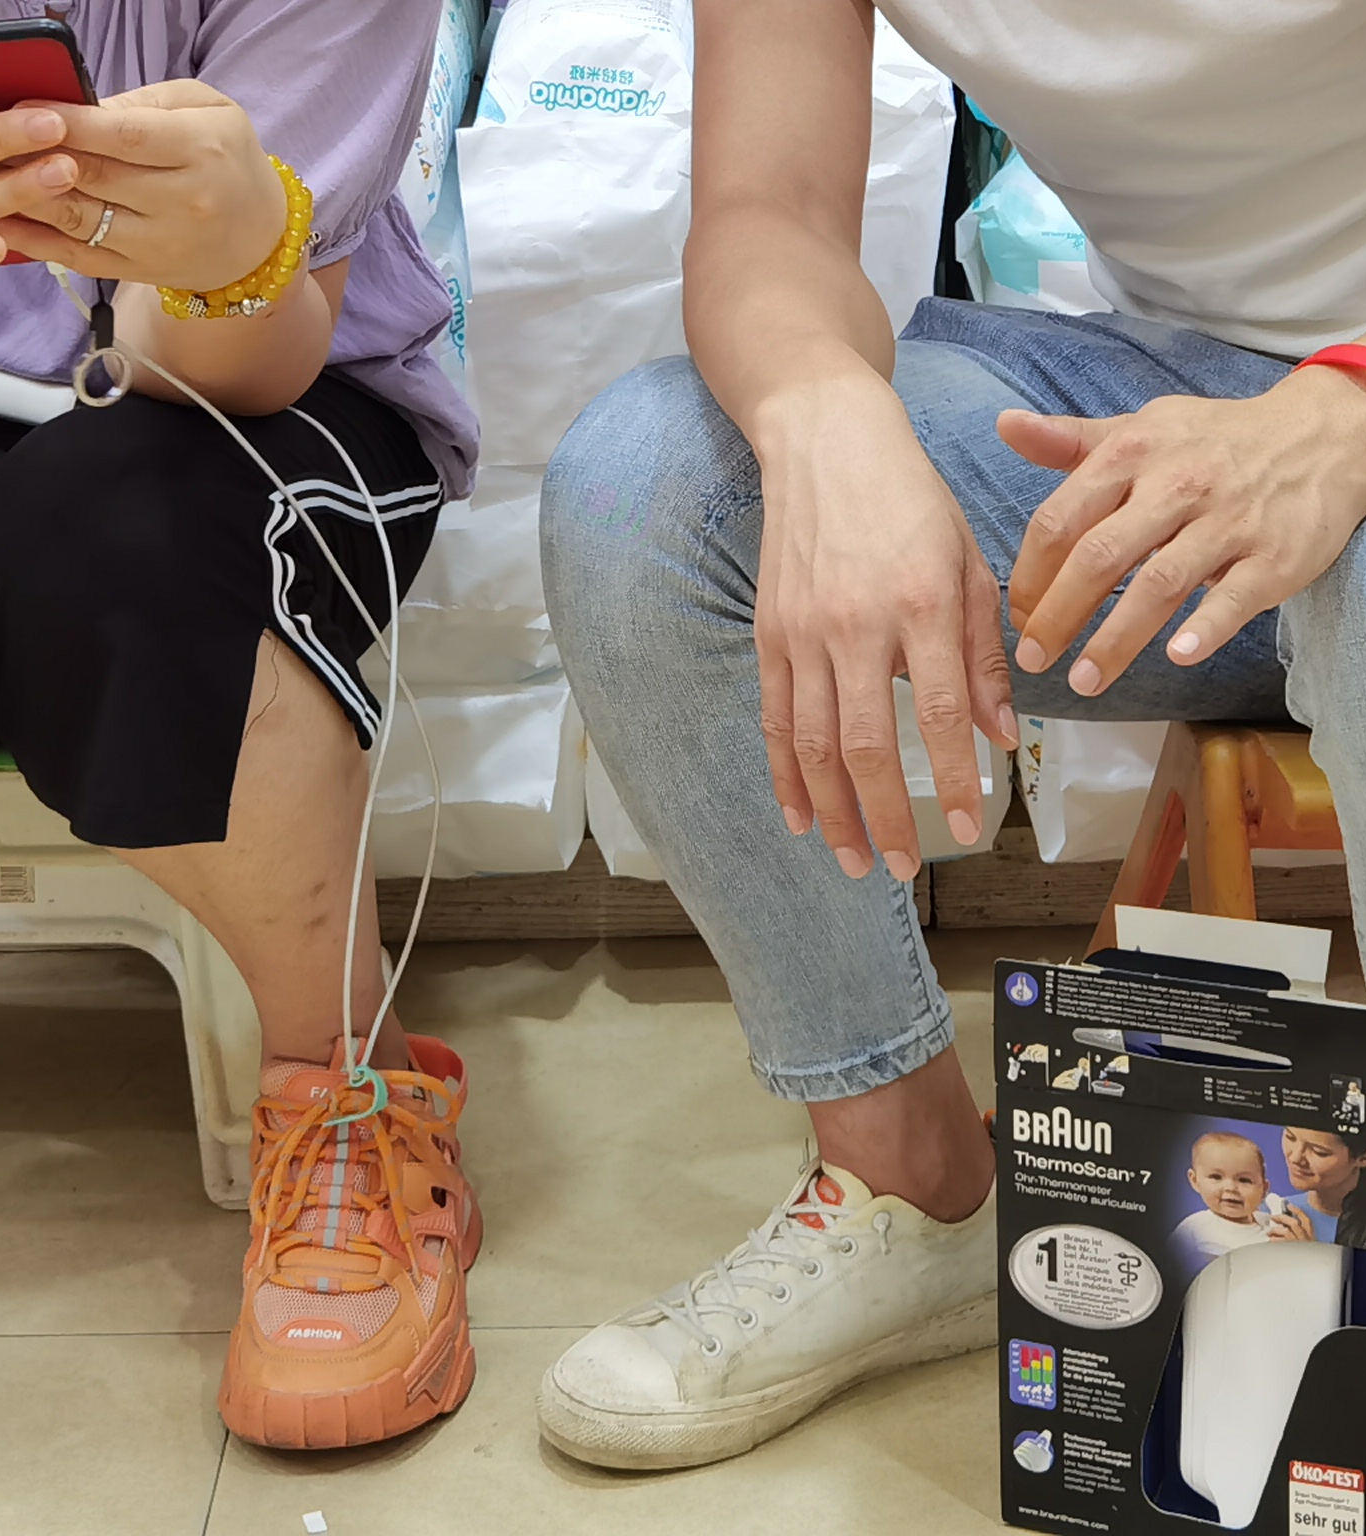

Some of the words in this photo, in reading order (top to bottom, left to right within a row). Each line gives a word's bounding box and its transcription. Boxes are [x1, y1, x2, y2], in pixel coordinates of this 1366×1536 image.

[529, 80, 666, 116] Mamamia
[1012, 1105, 1113, 1155] BRAUN
[1014, 1150, 1130, 1181] ThermoScan
[1139, 1170, 1152, 1185] 7
[1014, 1171, 1112, 1196] Ohr-Thermometer
[1090, 1196, 1147, 1213] auriculaire
[1294, 1512, 1327, 1528] sehr
[1332, 1519, 1357, 1534] gut
